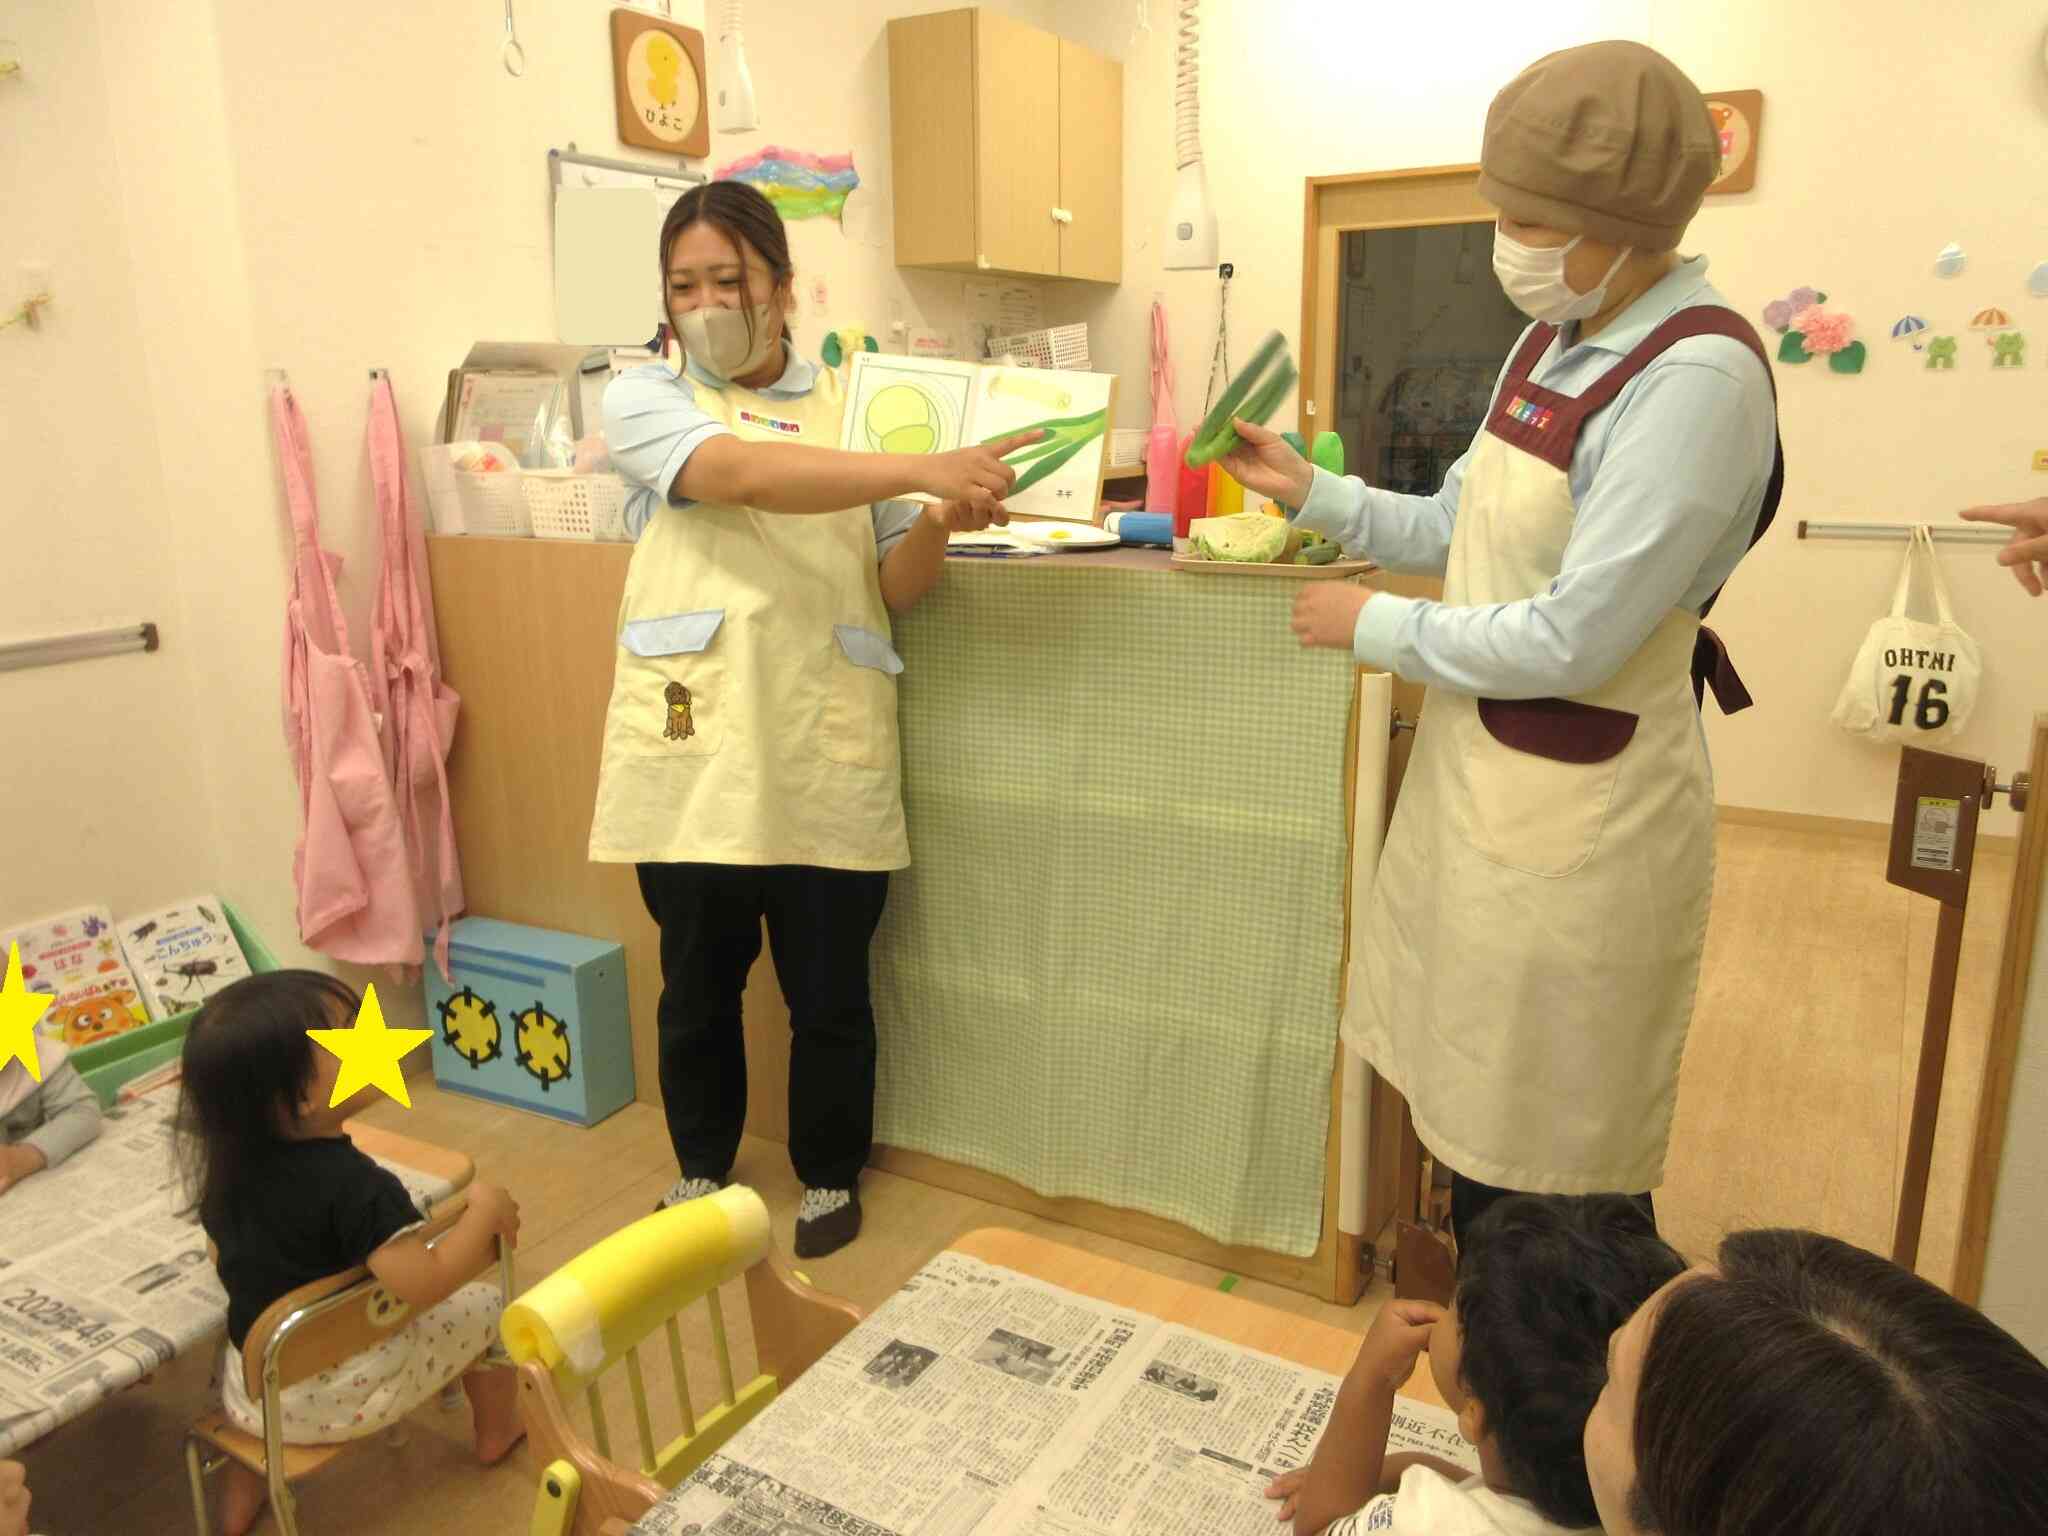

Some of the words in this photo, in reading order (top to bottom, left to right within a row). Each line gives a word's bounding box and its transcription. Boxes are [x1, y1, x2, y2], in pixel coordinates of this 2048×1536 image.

[645, 108, 683, 132] ひよこ
[1887, 673, 1950, 730] 16
